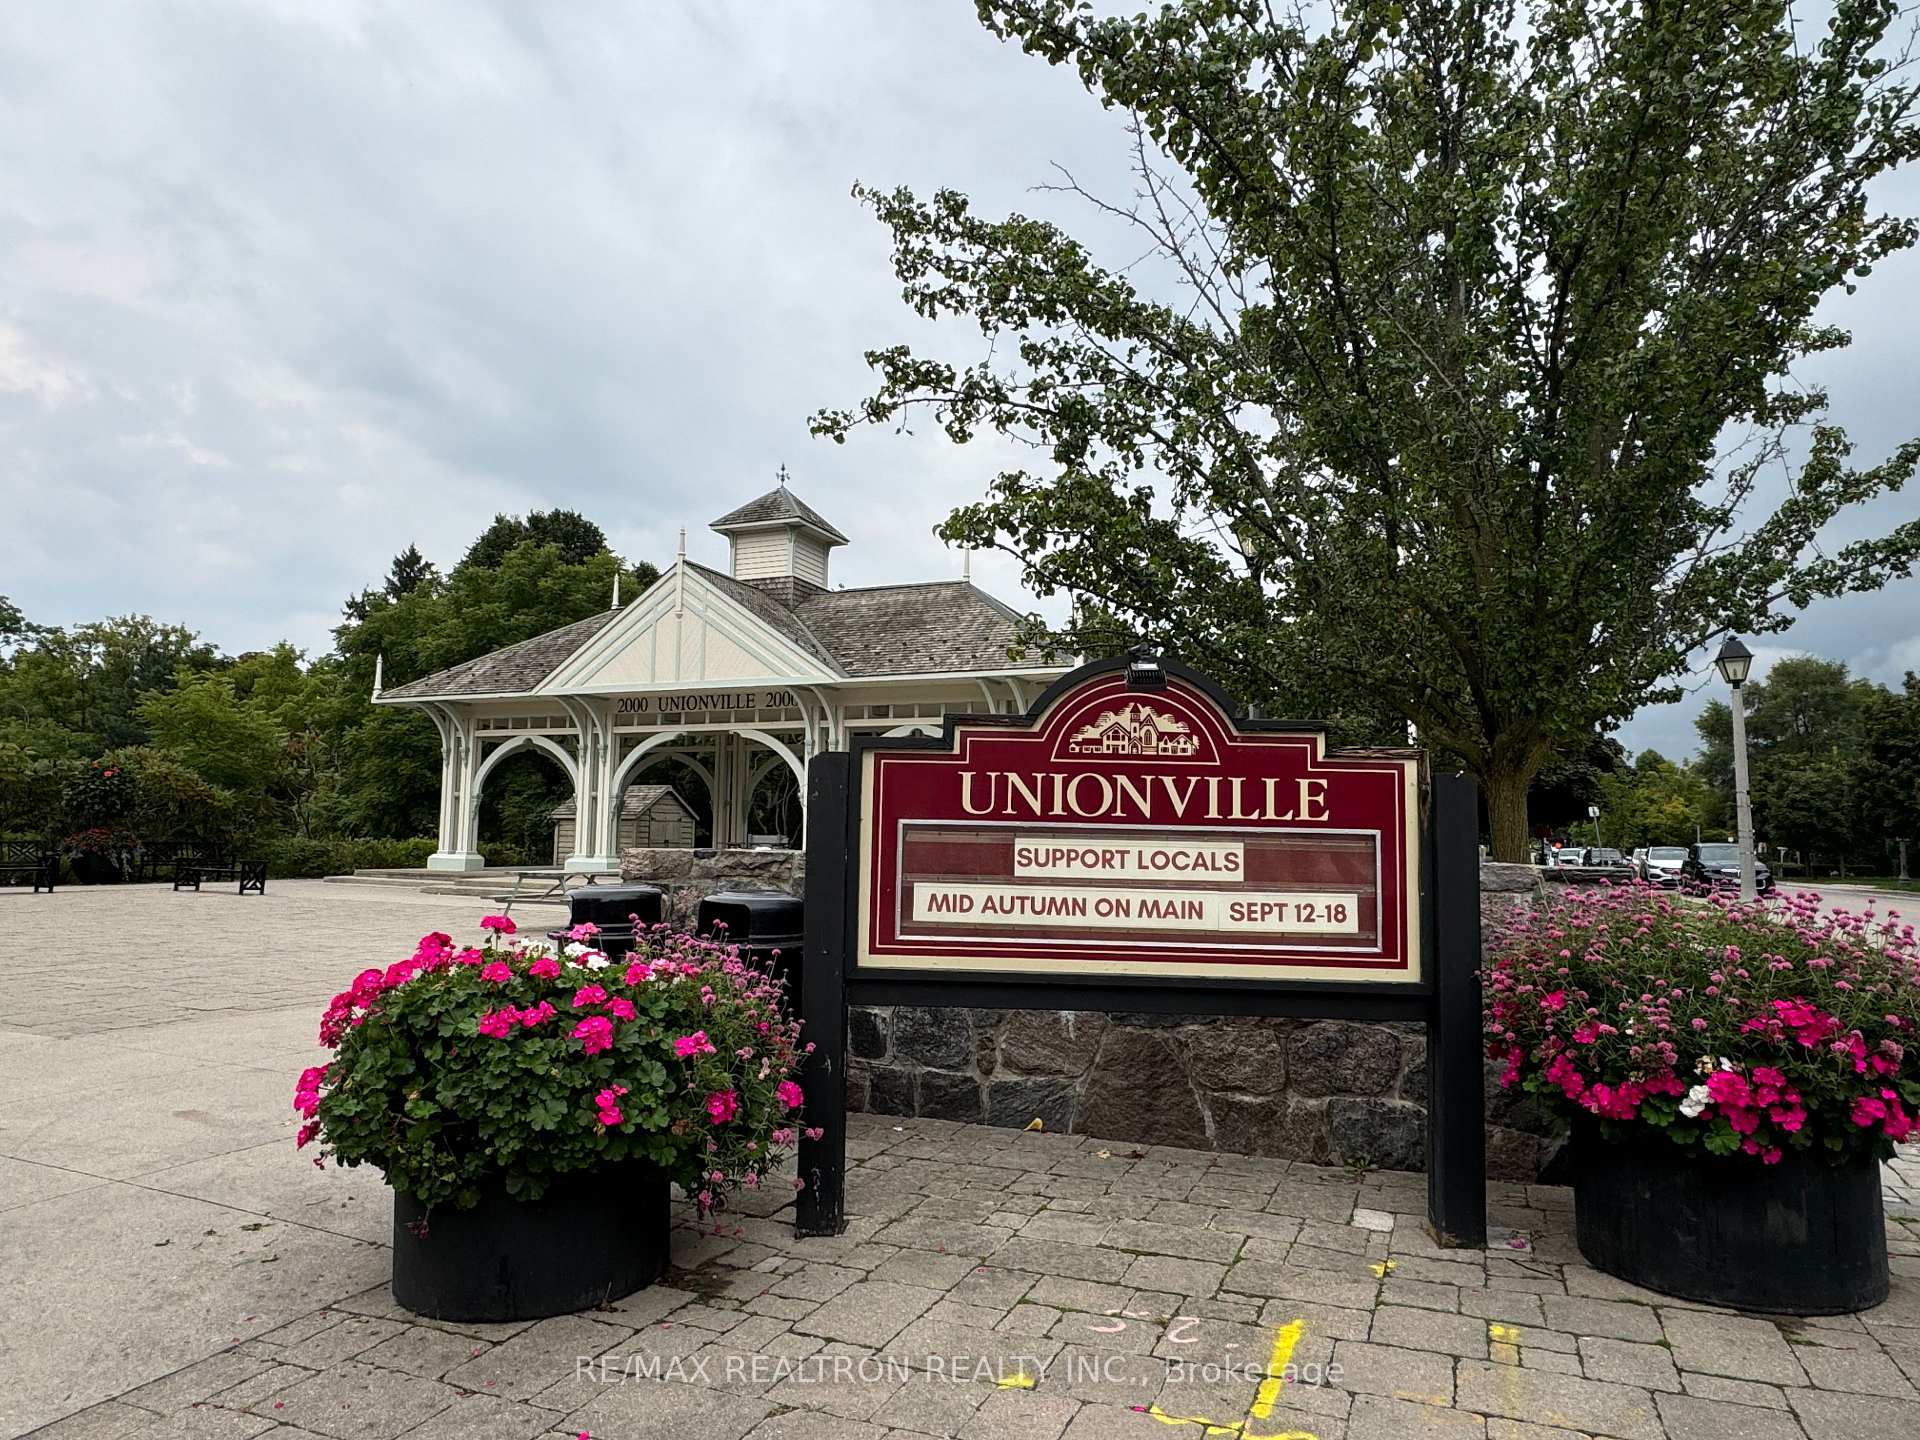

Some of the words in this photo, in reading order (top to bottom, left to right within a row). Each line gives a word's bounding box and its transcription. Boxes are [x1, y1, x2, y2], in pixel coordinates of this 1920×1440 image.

[618, 698, 648, 713] 2000
[658, 693, 756, 711] UNIONVILLE
[958, 771, 1330, 822] UNIONVILLE
[1016, 847, 1131, 870] SUPPORT
[1138, 851, 1240, 873] LOCALS
[927, 893, 974, 914] MID
[981, 895, 1087, 917] AUTUMN
[1094, 898, 1131, 918] ON
[1138, 900, 1204, 921] MAIN
[1229, 902, 1288, 923] SEPT
[1294, 903, 1347, 924] 12-18
